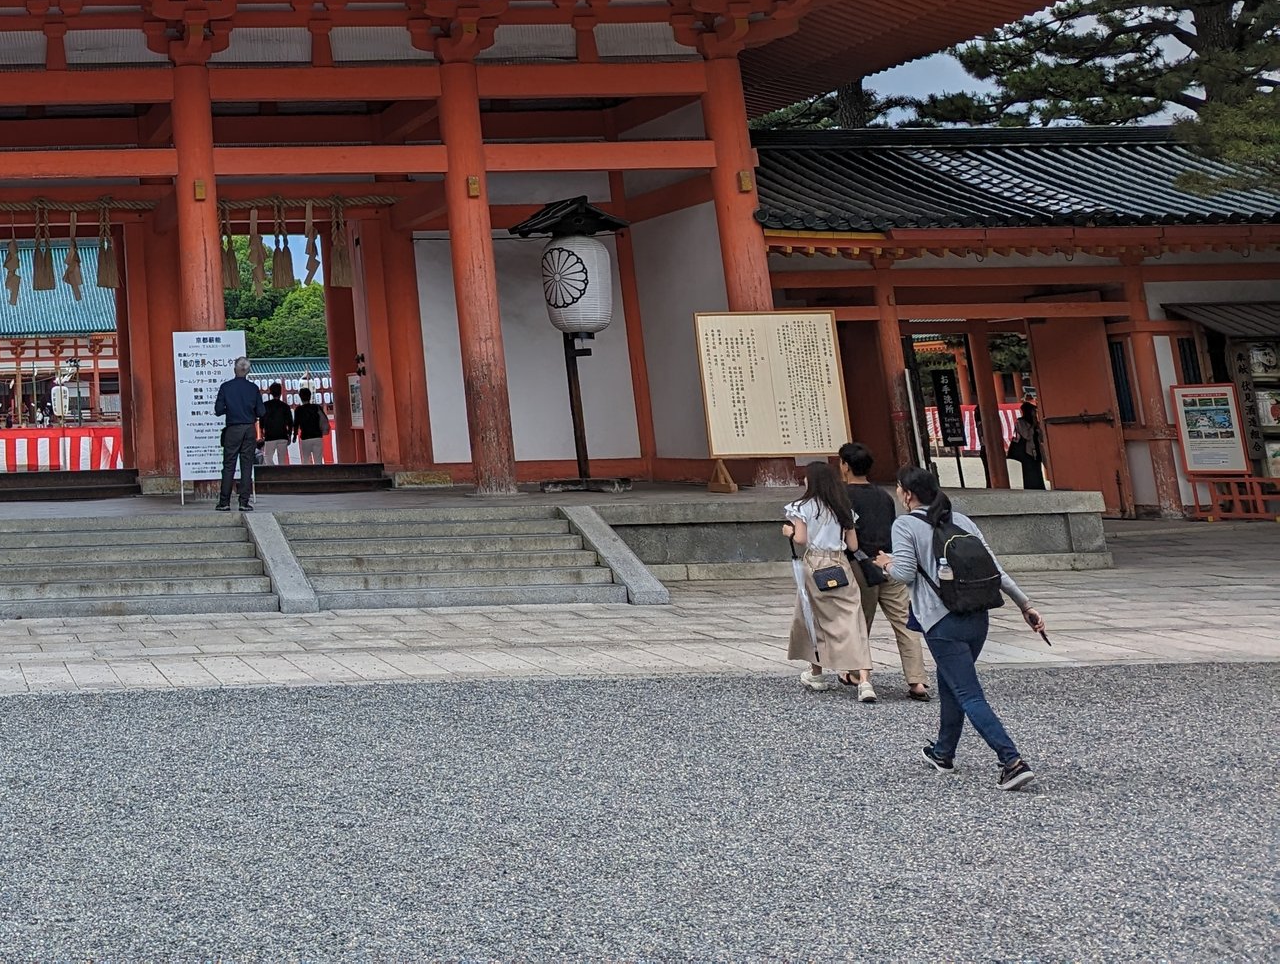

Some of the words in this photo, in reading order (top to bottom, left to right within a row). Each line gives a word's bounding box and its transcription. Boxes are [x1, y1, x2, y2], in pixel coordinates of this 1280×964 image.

[1241, 380, 1262, 452] 伏見酒造組合
